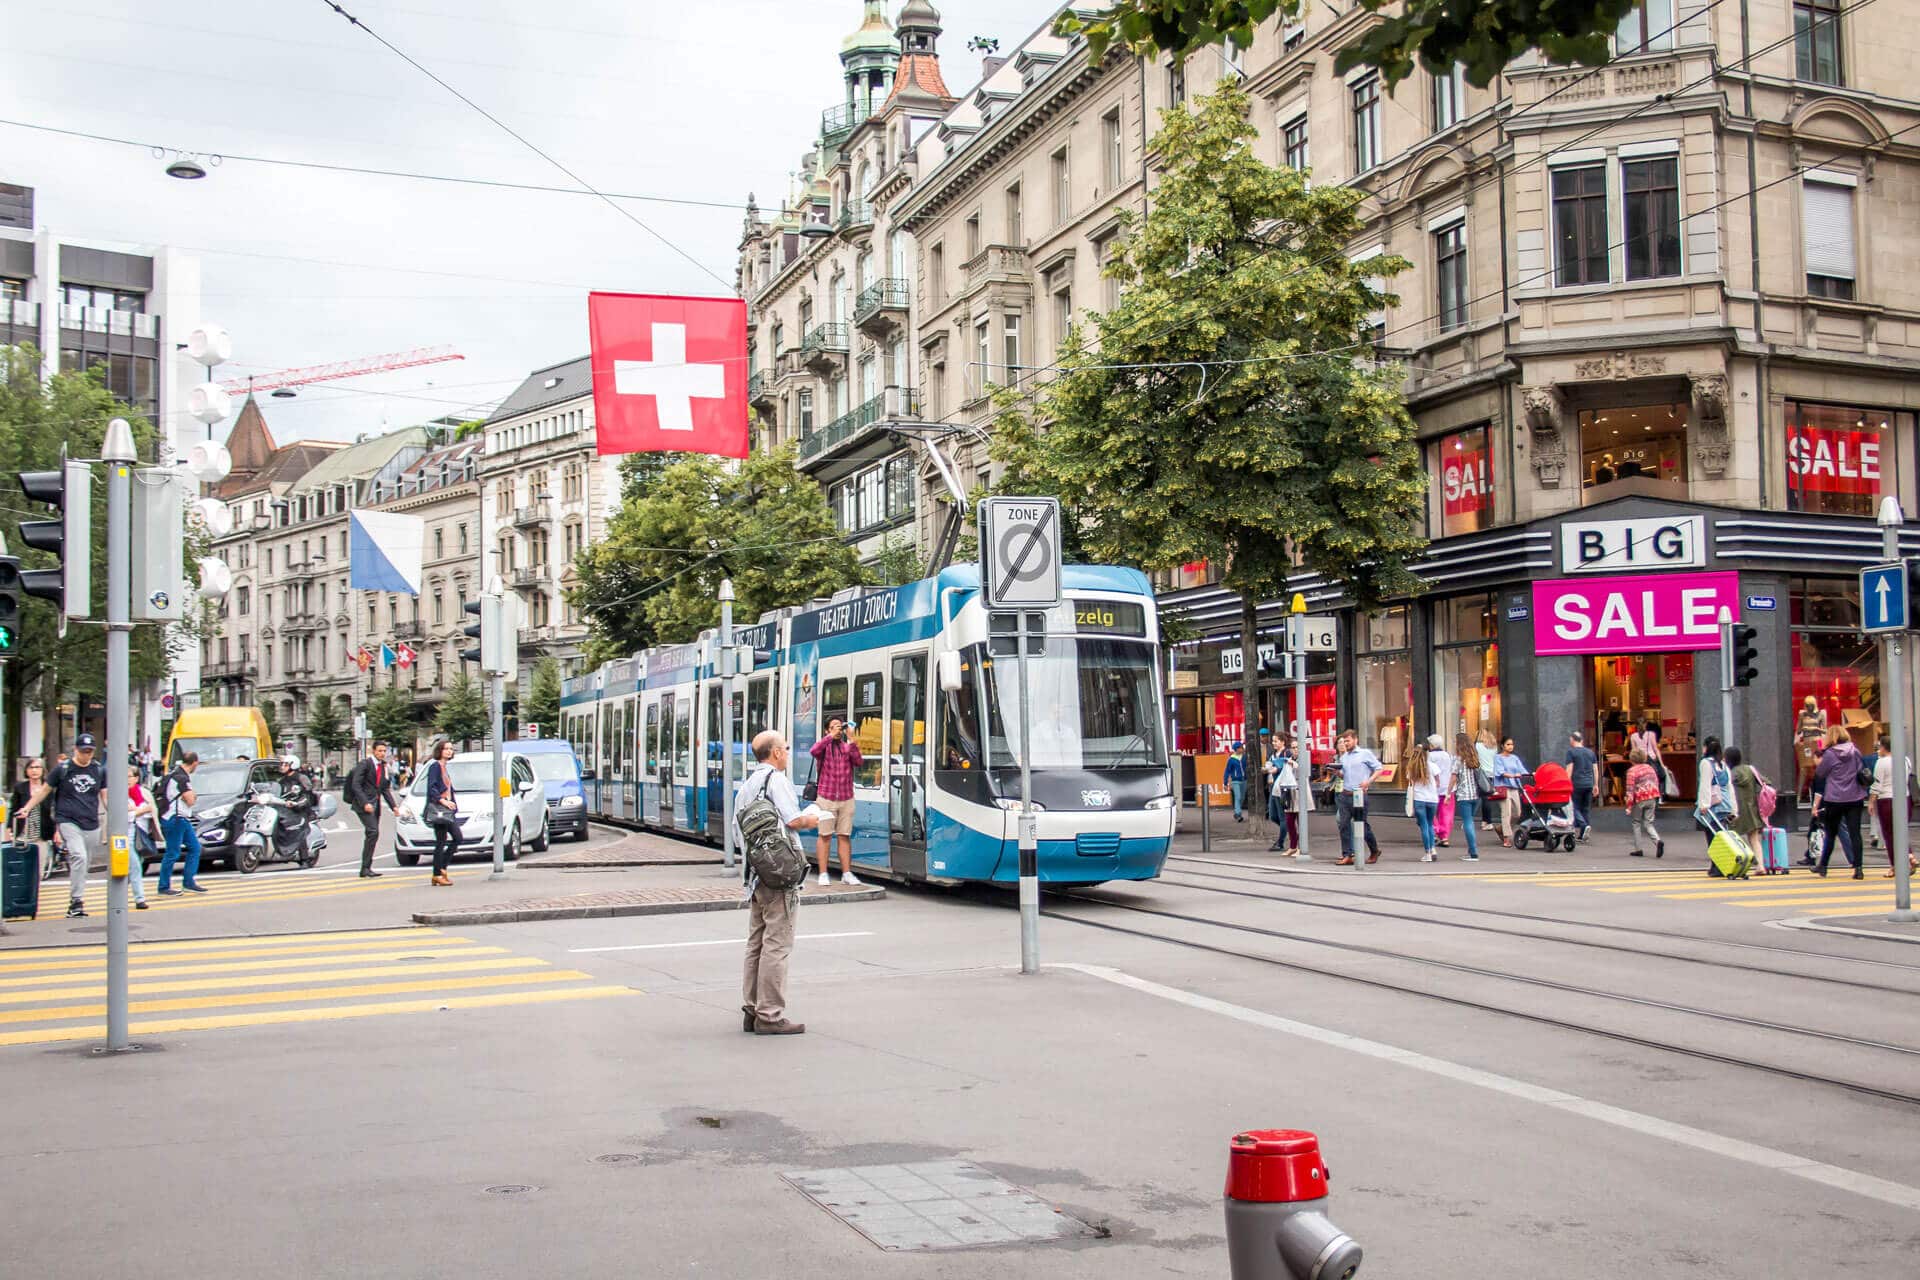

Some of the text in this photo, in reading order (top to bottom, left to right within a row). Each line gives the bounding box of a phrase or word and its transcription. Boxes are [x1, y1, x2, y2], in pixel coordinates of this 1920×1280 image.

[1623, 450, 1645, 459] BIG
[1789, 436, 1880, 479] SALE
[1008, 508, 1039, 521] ZONE
[1578, 526, 1684, 562] BIG
[818, 604, 850, 635] THEATER
[853, 601, 862, 627] 11
[1553, 588, 1719, 641] SALE
[1292, 633, 1333, 647] IG
[1223, 653, 1241, 669] BIG
